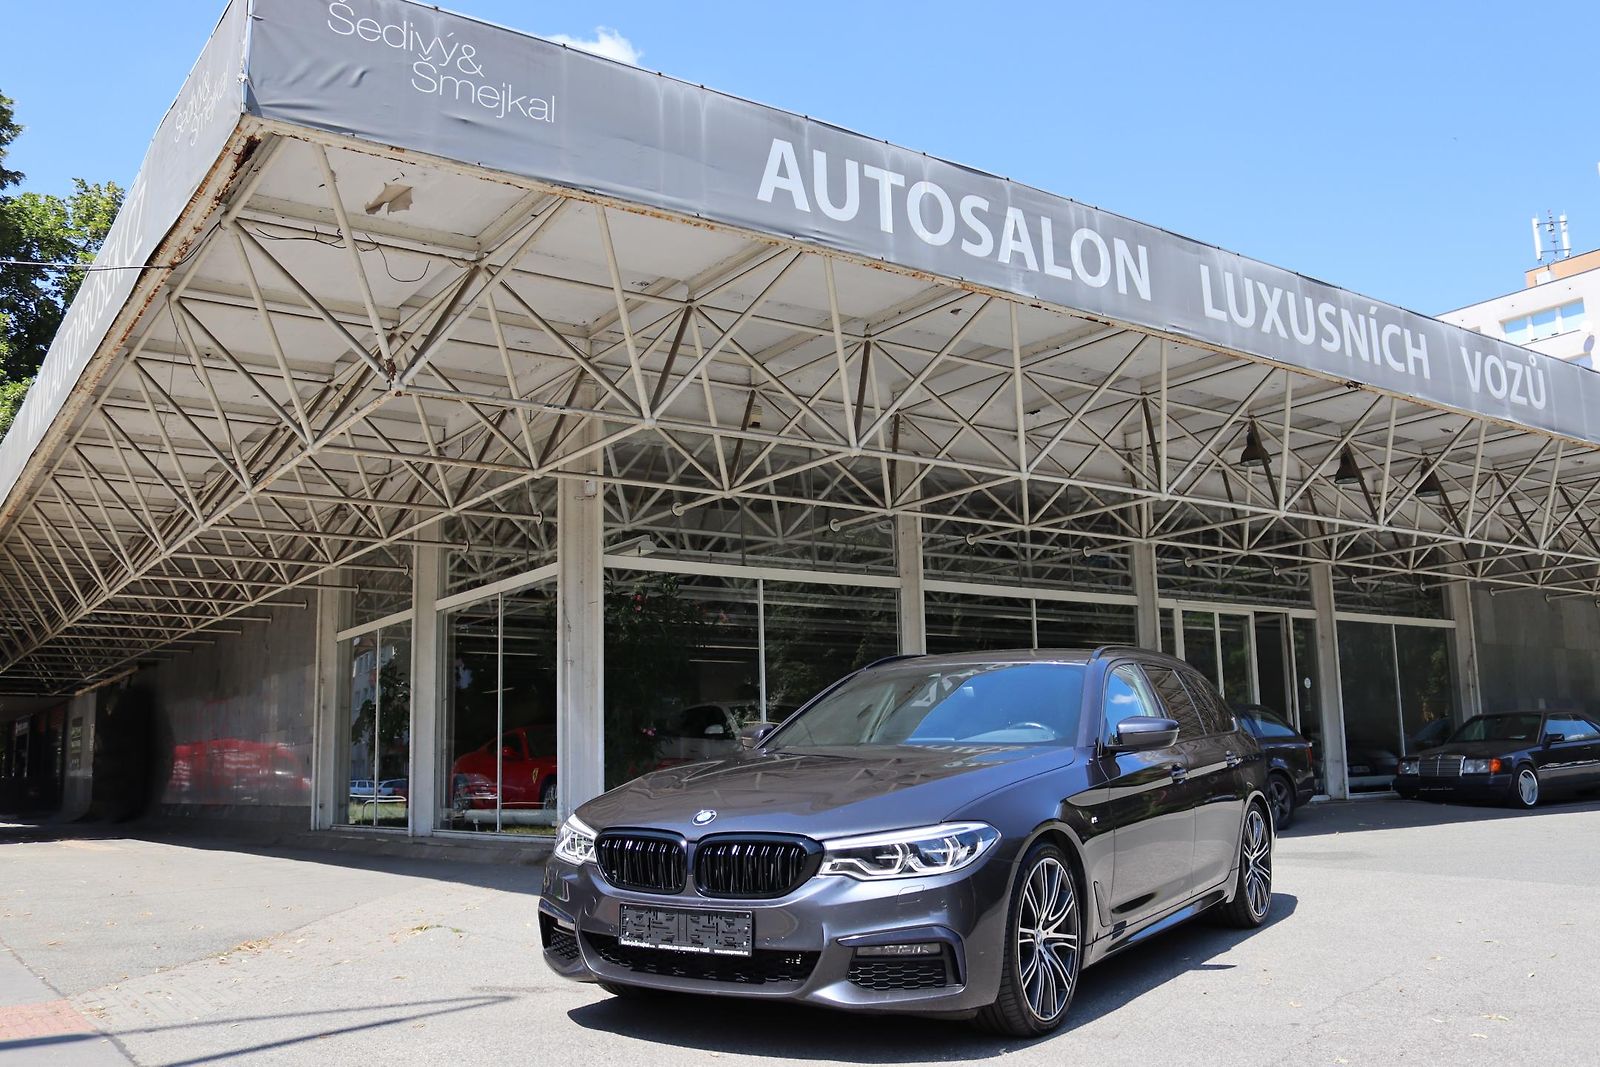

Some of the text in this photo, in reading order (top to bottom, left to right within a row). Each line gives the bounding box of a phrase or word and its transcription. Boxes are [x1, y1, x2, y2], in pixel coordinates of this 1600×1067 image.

[411, 53, 555, 123] Šmejkal
[757, 138, 1547, 410] AUTOSALON LUXUSNÍCH VOZŮ
